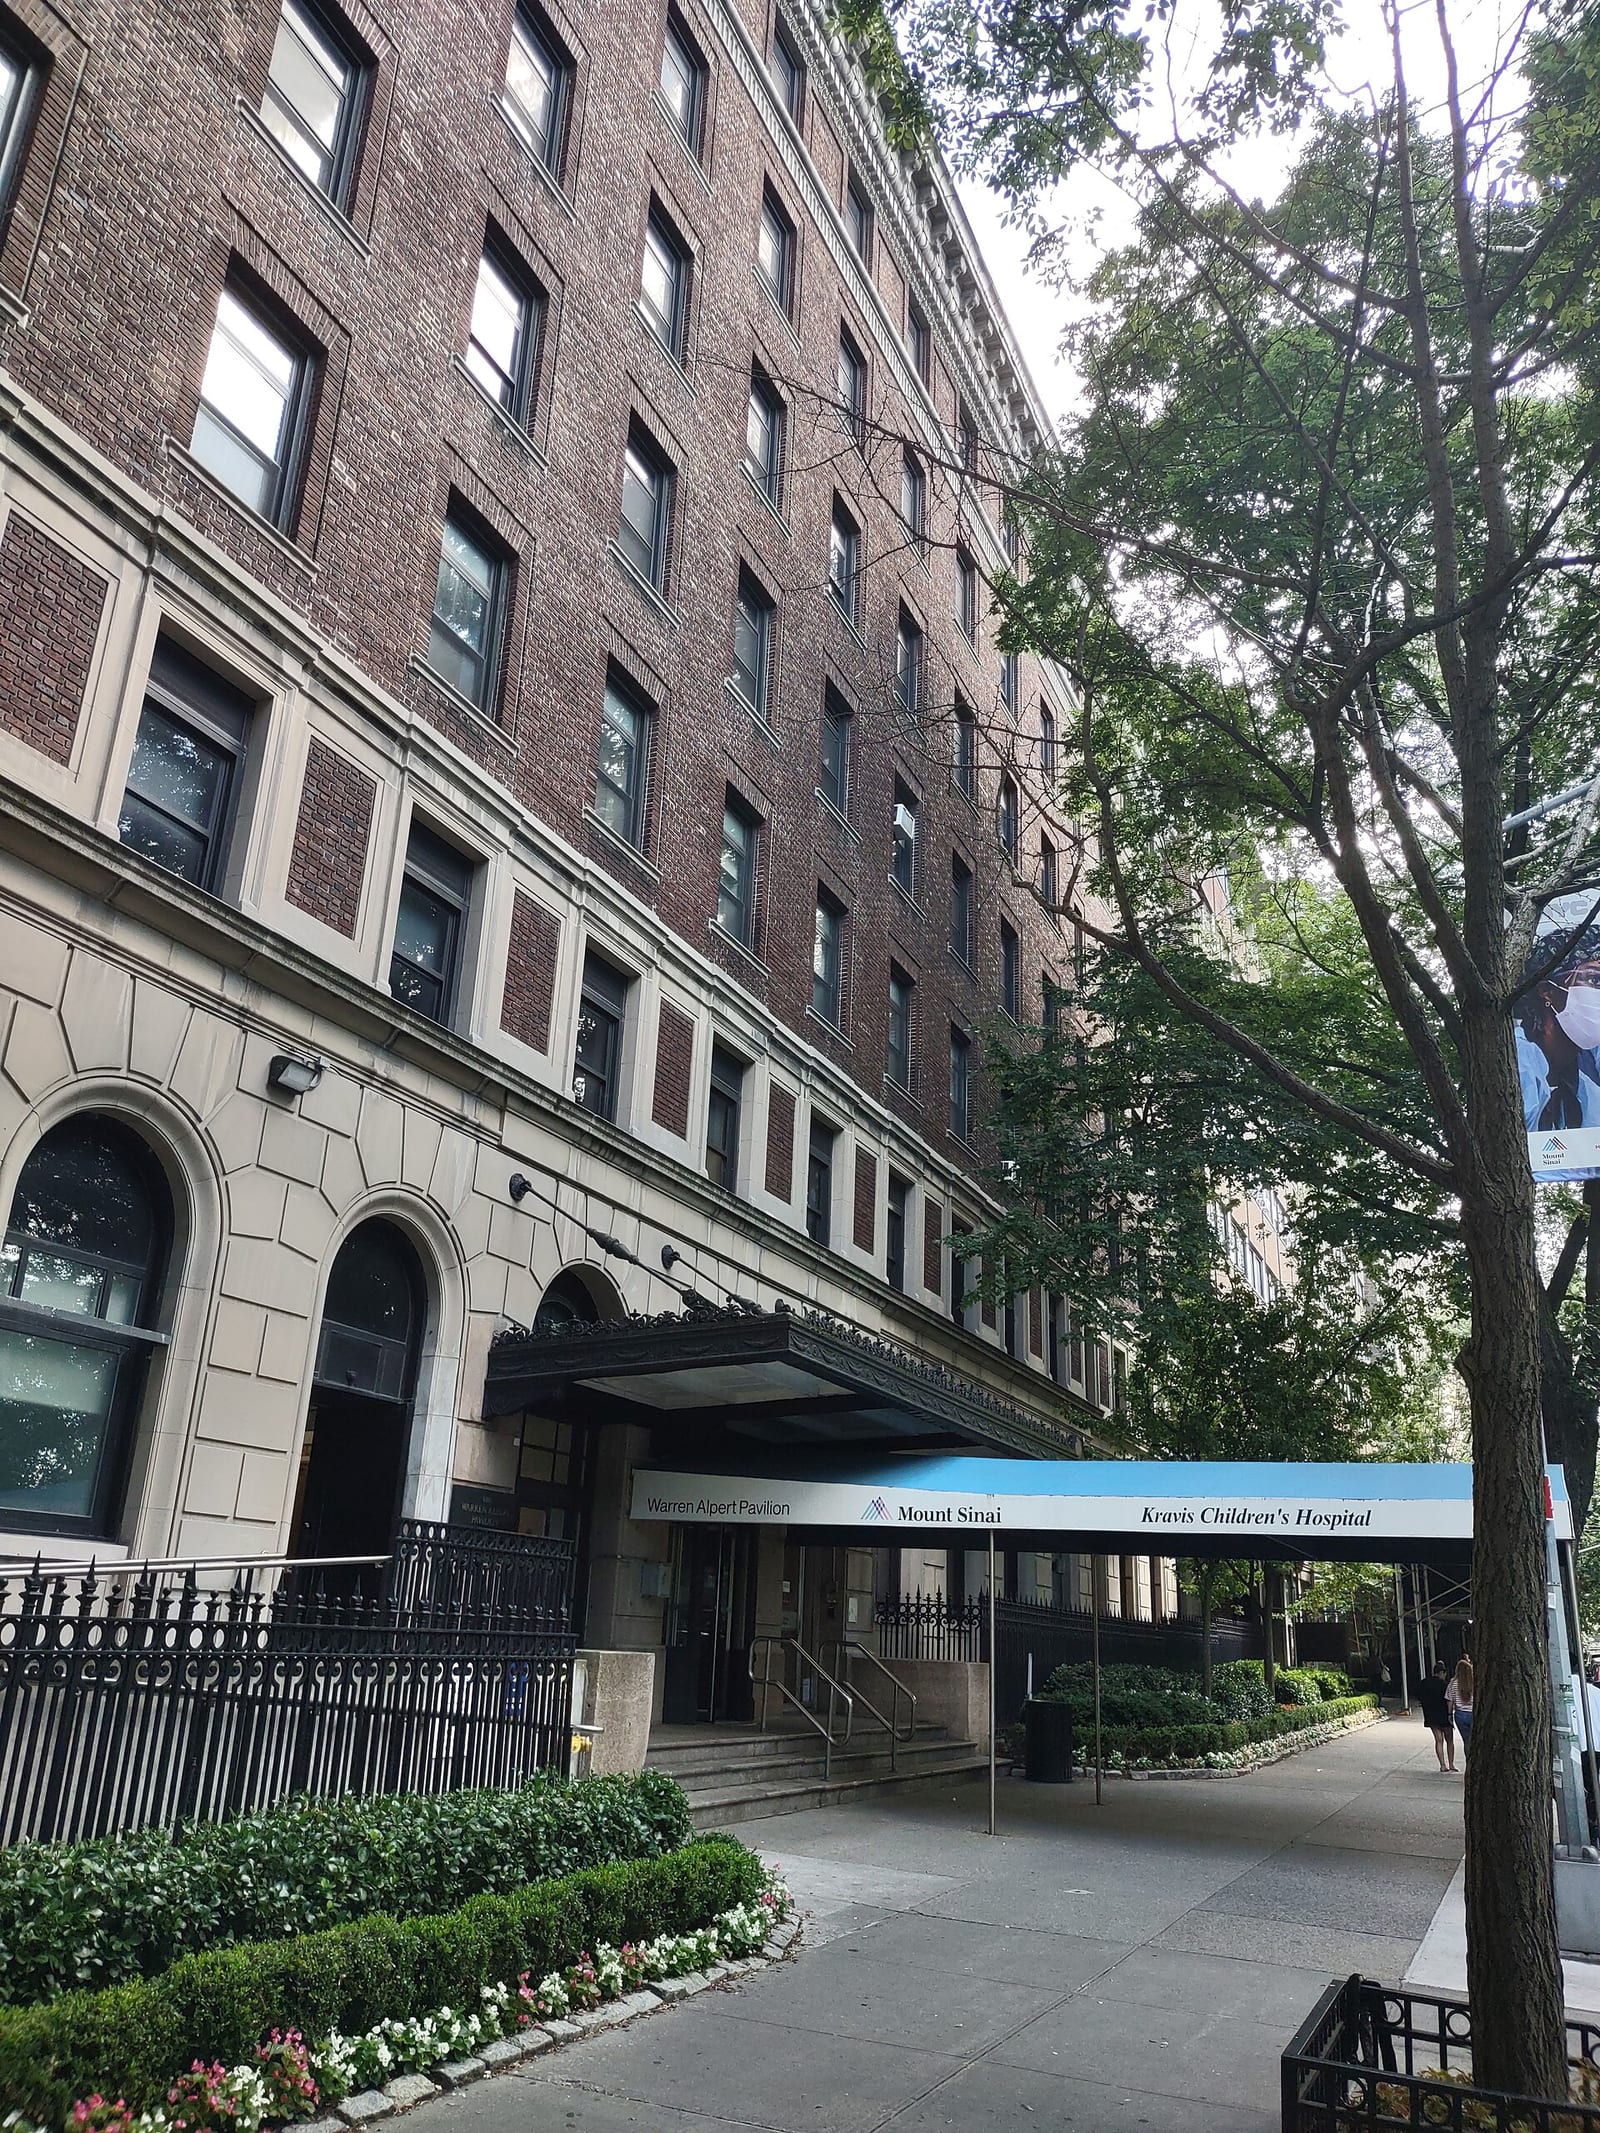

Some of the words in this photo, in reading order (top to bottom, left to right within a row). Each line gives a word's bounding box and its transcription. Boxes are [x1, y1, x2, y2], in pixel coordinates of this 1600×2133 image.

[1542, 1152, 1565, 1160] Mount
[647, 1497, 694, 1514] Warren
[696, 1499, 737, 1516] Alpert
[739, 1500, 790, 1515] Pavilion
[898, 1506, 953, 1521] Mount
[957, 1506, 1002, 1523] Sinai
[1141, 1507, 1195, 1523] Kravis
[1199, 1507, 1290, 1525] Children's
[1295, 1509, 1372, 1531] Hospital
